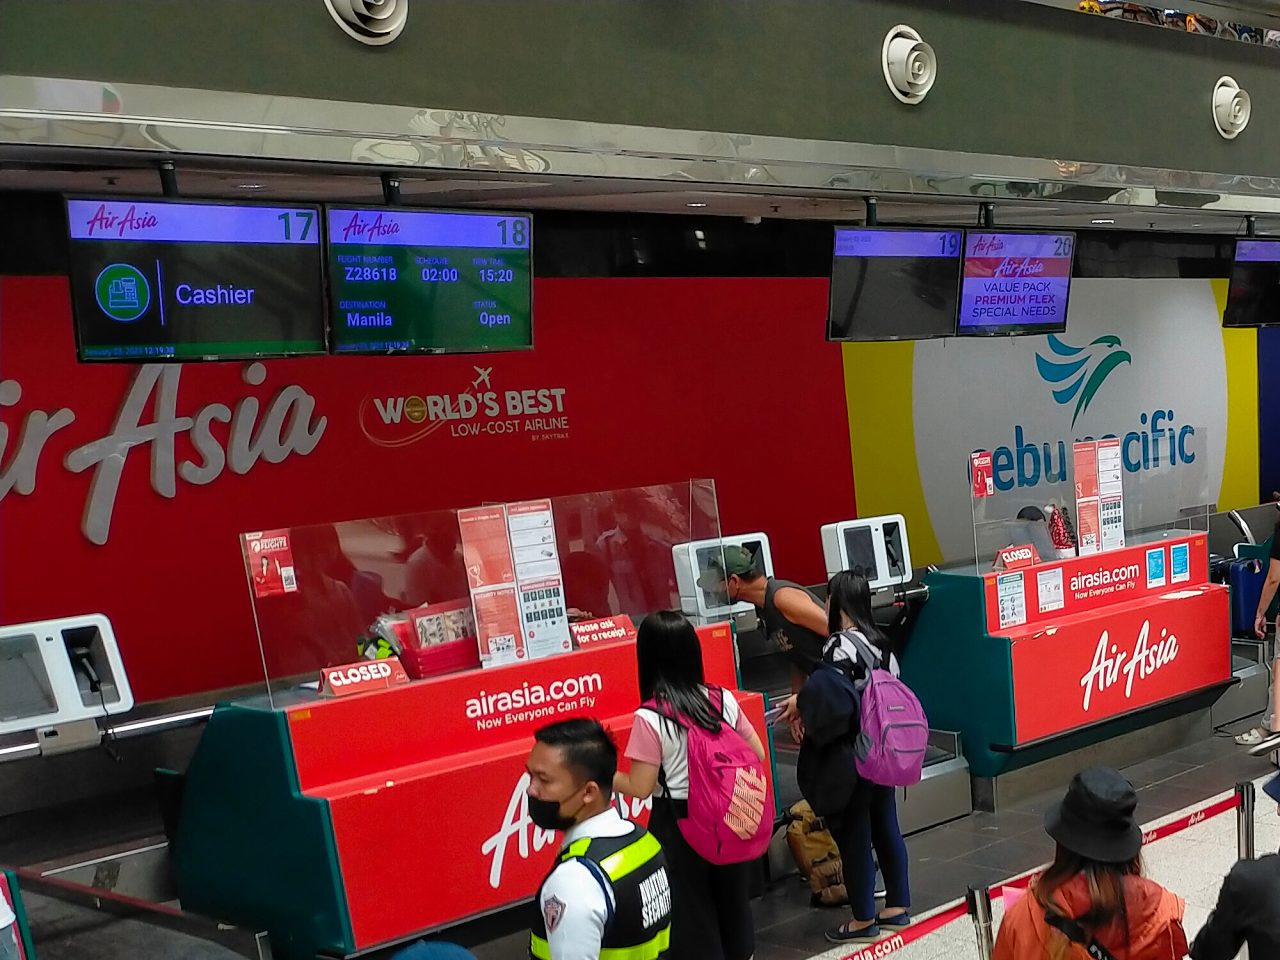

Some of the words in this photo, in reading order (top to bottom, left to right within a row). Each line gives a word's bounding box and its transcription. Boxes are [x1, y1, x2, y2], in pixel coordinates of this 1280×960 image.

[278, 212, 313, 241] 17
[497, 219, 526, 246] 18
[939, 231, 958, 255] 19
[1054, 237, 1071, 256] 20
[345, 267, 397, 281] Z28618
[421, 268, 458, 282] 02:00
[480, 269, 513, 282] 15:20
[176, 284, 255, 305] Cashier
[983, 282, 1020, 292] VALUE
[1023, 282, 1050, 292] PACK
[975, 295, 1026, 305] PREMIUM
[1029, 294, 1055, 304] FLEX
[347, 312, 392, 327] Manila
[479, 312, 511, 328] Open
[972, 307, 1019, 318] SPECIAL
[1021, 306, 1056, 316] NEEDS
[374, 391, 500, 424] WORLD'S
[505, 388, 566, 415] BEST
[451, 420, 520, 437] LOW-COST
[524, 416, 569, 431] AIRLINE
[968, 425, 1067, 491] ebu
[1076, 410, 1196, 473] cific
[1002, 548, 1032, 563] CLOSED
[1070, 564, 1140, 591] airasia.com
[1075, 591, 1088, 601] Now
[1089, 586, 1114, 598] Everyone
[1115, 583, 1127, 592] Can
[1127, 581, 1135, 590] Fly
[572, 623, 599, 634] Please
[600, 619, 616, 629] ask
[577, 633, 590, 644] for
[591, 633, 599, 642] a
[599, 627, 627, 641] receipt
[328, 662, 391, 687] CLOSED
[465, 673, 602, 718] airasia.com
[477, 717, 502, 731] Now
[505, 706, 555, 725] Everyone
[557, 701, 577, 713] Can
[580, 696, 596, 708] Fly
[639, 865, 669, 907] AVIATION
